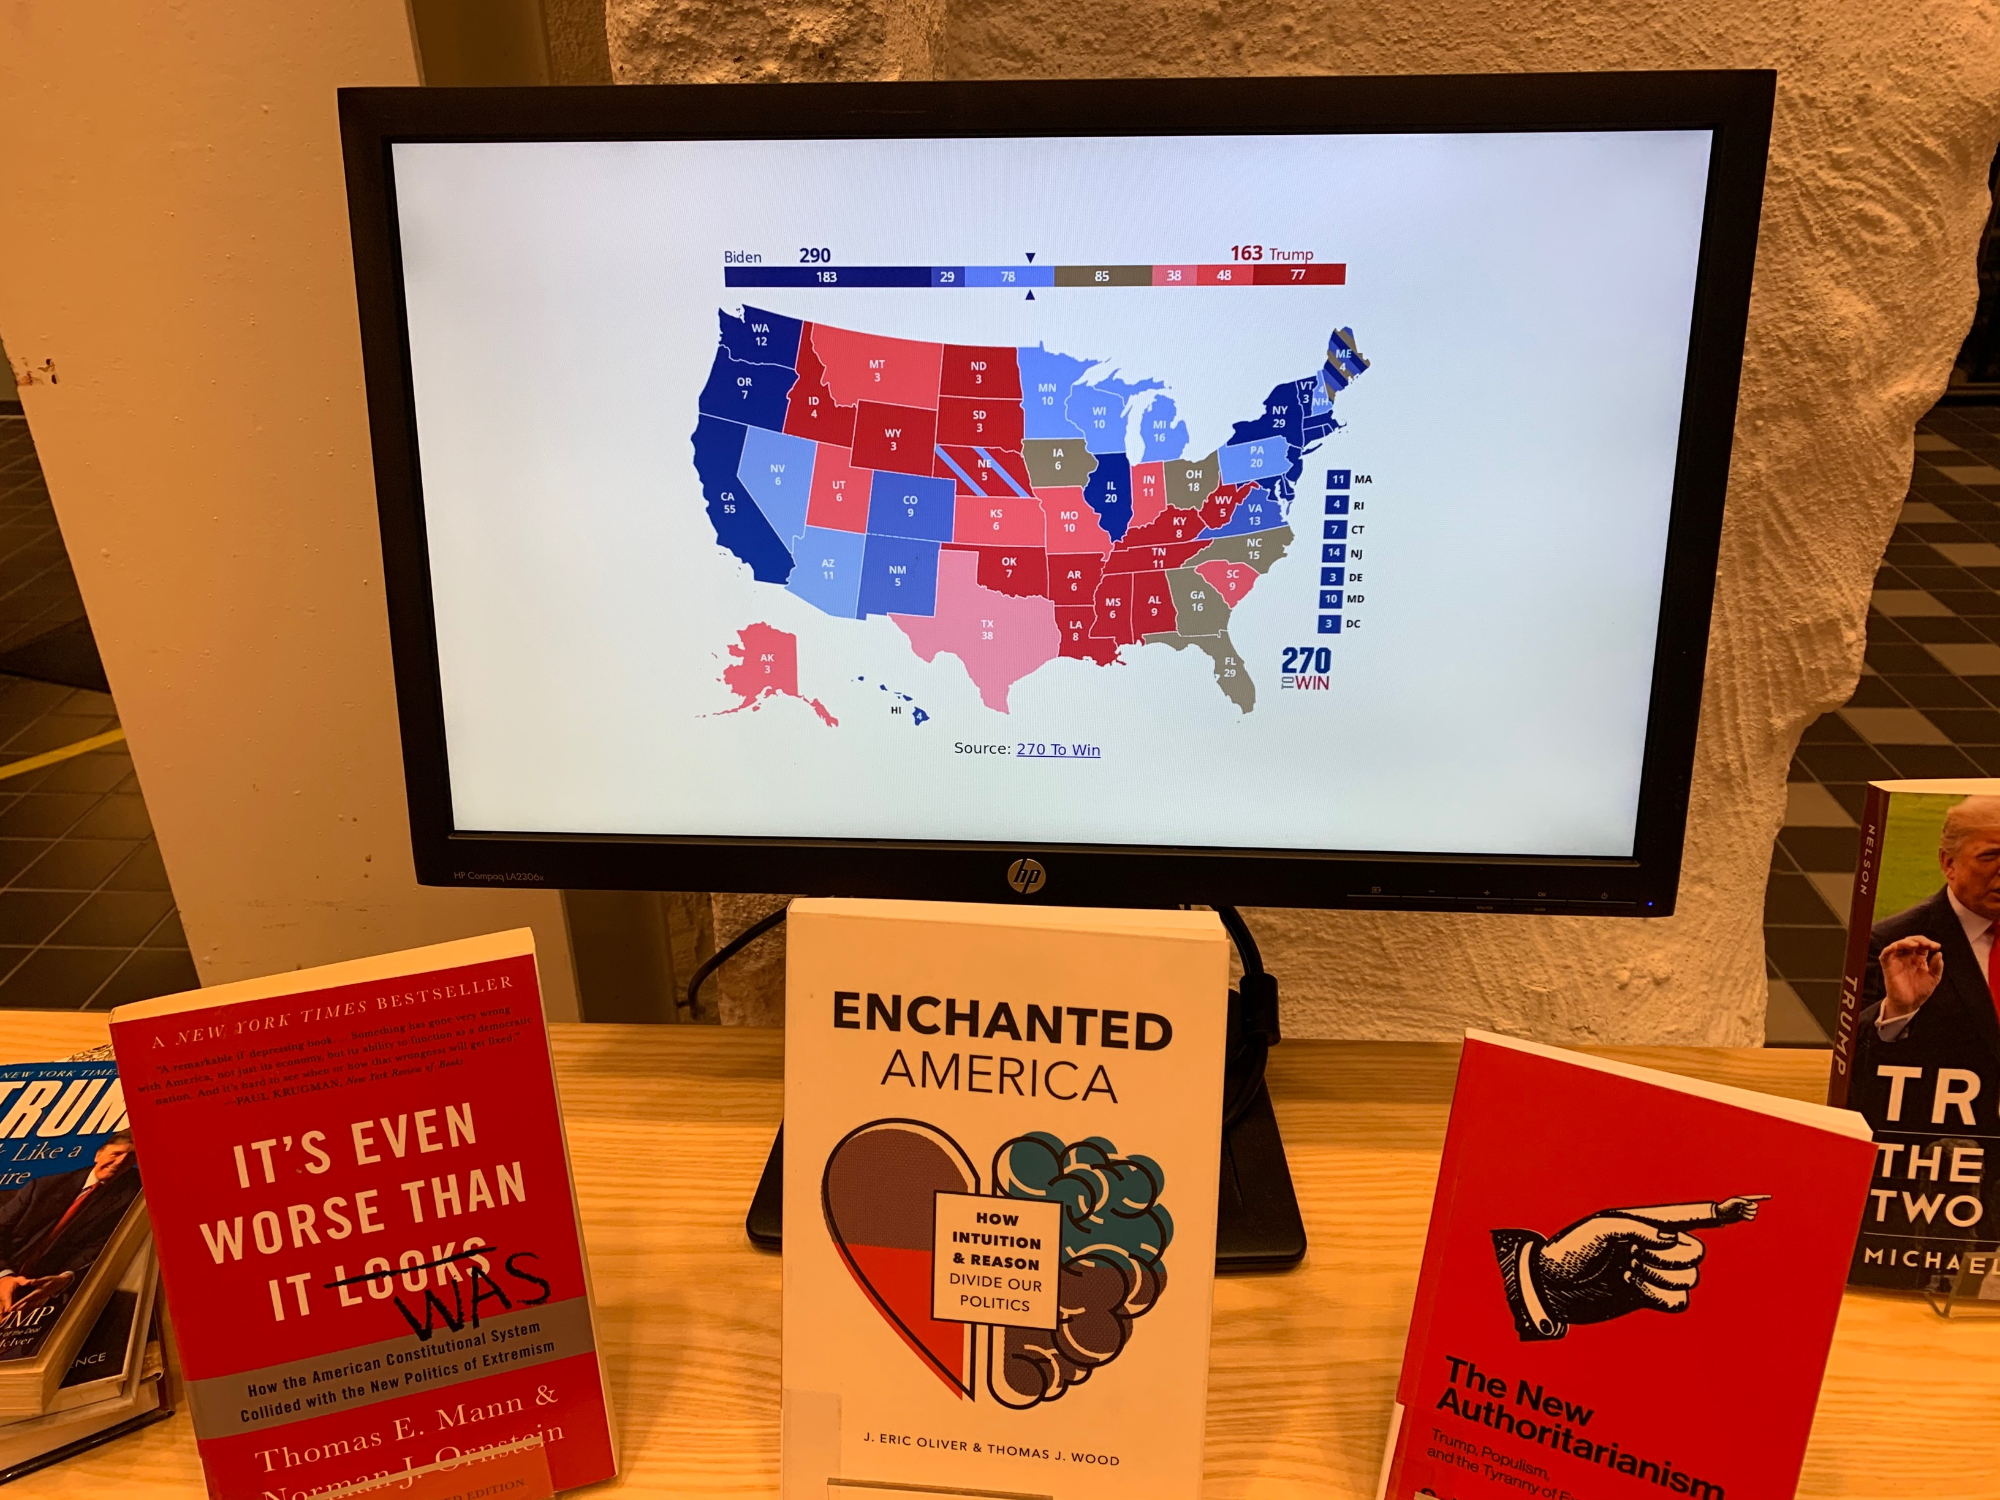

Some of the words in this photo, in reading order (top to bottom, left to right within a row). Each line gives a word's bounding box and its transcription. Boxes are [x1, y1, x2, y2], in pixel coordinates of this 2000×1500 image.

[724, 250, 763, 264] Biden
[799, 248, 832, 264] 290
[1230, 246, 1263, 261] 163
[1270, 248, 1314, 265] Trump
[816, 271, 838, 284] 183
[940, 271, 956, 283] 29
[1001, 271, 1016, 283] 78
[1094, 270, 1110, 282] 85
[1166, 270, 1182, 282] 38
[1216, 270, 1232, 281] 48
[1291, 269, 1306, 280] 77
[751, 324, 770, 334] WA
[755, 337, 768, 346] 12
[1335, 349, 1352, 359] ME
[869, 360, 886, 369] MT
[1038, 383, 1057, 393] MN
[1041, 396, 1054, 406] 10
[1272, 406, 1289, 415] NY
[1153, 420, 1167, 430] MI
[1272, 419, 1286, 428] 29
[1154, 433, 1166, 443] 16
[1250, 446, 1265, 456] PA
[1250, 458, 1264, 468] 20
[1186, 470, 1203, 480] OH
[1332, 474, 1345, 484] 11
[1354, 475, 1373, 484] MA
[1107, 481, 1117, 491] IL
[1188, 482, 1200, 492] 18
[720, 492, 735, 502] CA
[1105, 494, 1118, 504] 20
[724, 504, 736, 514] 55
[1248, 504, 1263, 514] VA
[1249, 516, 1261, 526] 13
[1246, 538, 1263, 548] NC
[1248, 550, 1260, 561] 15
[1328, 548, 1341, 557] 14
[1350, 549, 1364, 560] NJ
[822, 559, 835, 568] AZ
[823, 571, 835, 580] 11
[1190, 590, 1206, 600] GA
[1326, 594, 1338, 604] 10
[1347, 595, 1365, 604] MD
[1192, 603, 1204, 612] 16
[981, 620, 994, 629] TX
[981, 632, 994, 641] 38
[760, 654, 775, 662] AK
[1225, 657, 1237, 667] FL
[1281, 646, 1332, 674] 270
[1224, 669, 1237, 678] 29
[1295, 676, 1330, 690] WIN
[891, 706, 902, 715] HI
[954, 742, 1011, 755] Source:
[1017, 744, 1046, 756] 270
[1051, 744, 1067, 756] To
[1072, 743, 1101, 757] Win
[1860, 824, 1876, 896] NELSON
[454, 871, 466, 880] HP
[468, 872, 505, 882] Compaq
[505, 872, 545, 881] LA2306x
[1012, 858, 1042, 894] hp
[152, 1036, 165, 1049] A
[176, 1025, 225, 1046] NEW
[234, 1014, 290, 1035] YORK
[301, 1000, 367, 1024] TIMES
[377, 976, 513, 1010] BESTSELLER
[833, 991, 1173, 1051] ENCHANTED
[1834, 975, 1858, 1076] TRUMP
[173, 1054, 233, 1072] remarkable
[236, 1052, 245, 1061] if
[250, 1042, 305, 1058] depressing
[351, 1024, 406, 1040] Something
[408, 1021, 426, 1031] has
[429, 1017, 452, 1029] gone
[456, 1012, 477, 1023] very
[480, 1006, 511, 1018] wrong
[0, 1071, 35, 1079] NEW
[38, 1070, 77, 1078] YORK
[273, 1078, 344, 1099] KRUGMAN,
[346, 1076, 366, 1086] New
[370, 1071, 388, 1081] York
[391, 1066, 423, 1078] Review
[425, 1062, 435, 1072] of
[439, 1058, 464, 1069] Books
[881, 1049, 1119, 1104] AMERICA
[1877, 1065, 2000, 1126] TR
[0, 1077, 131, 1139] TRUM
[351, 1102, 477, 1166] EVEN
[10, 1141, 64, 1162] Like
[68, 1146, 83, 1158] a
[1878, 1142, 1985, 1184] THE
[200, 1189, 385, 1265] WORSE
[401, 1161, 527, 1224] THAN
[1870, 1189, 1984, 1228] TWO
[976, 1212, 1019, 1227] HOW
[952, 1231, 1042, 1250] INTUITION
[953, 1252, 965, 1265] &
[971, 1254, 1040, 1271] REASON
[269, 1273, 312, 1322] IT
[334, 1236, 492, 1307] LOOKS
[950, 1273, 1003, 1289] DIVIDE
[1008, 1278, 1043, 1293] OUR
[394, 1252, 552, 1342] WAS
[960, 1294, 1030, 1313] POLITICS
[248, 1381, 278, 1397] How
[283, 1374, 307, 1390] the
[312, 1358, 381, 1384] American
[386, 1333, 487, 1367] Constitutional
[491, 1322, 541, 1343] System
[241, 1398, 301, 1423] Collided
[306, 1391, 337, 1409] with
[342, 1386, 366, 1401] the
[370, 1378, 400, 1394] New
[404, 1364, 459, 1385] Politics
[464, 1357, 478, 1372] of
[483, 1340, 555, 1368] Extremism
[1446, 1355, 1508, 1399] The
[1516, 1379, 1595, 1427] New
[254, 1431, 382, 1473] Thomas
[393, 1417, 425, 1442] E.
[435, 1397, 524, 1431] Mann
[535, 1385, 559, 1406] &
[864, 1432, 875, 1443] J.
[880, 1433, 912, 1447] ERIC
[916, 1437, 968, 1452] OLIVER
[973, 1442, 982, 1453] &
[988, 1444, 1050, 1460] THOMAS
[1054, 1450, 1066, 1462] J.
[1071, 1452, 1121, 1467] WOOD
[1436, 1387, 1725, 1500] Authoritarianism
[399, 1456, 422, 1490] J.
[435, 1424, 565, 1472] Ornstein
[1432, 1428, 1478, 1457] Trump,
[1481, 1446, 1550, 1482] Populism,
[1427, 1448, 1454, 1464] and
[1457, 1456, 1479, 1473] the
[1483, 1464, 1539, 1496] Tyranny
[1542, 1485, 1558, 1500] of
[467, 1478, 525, 1499] EDITION
